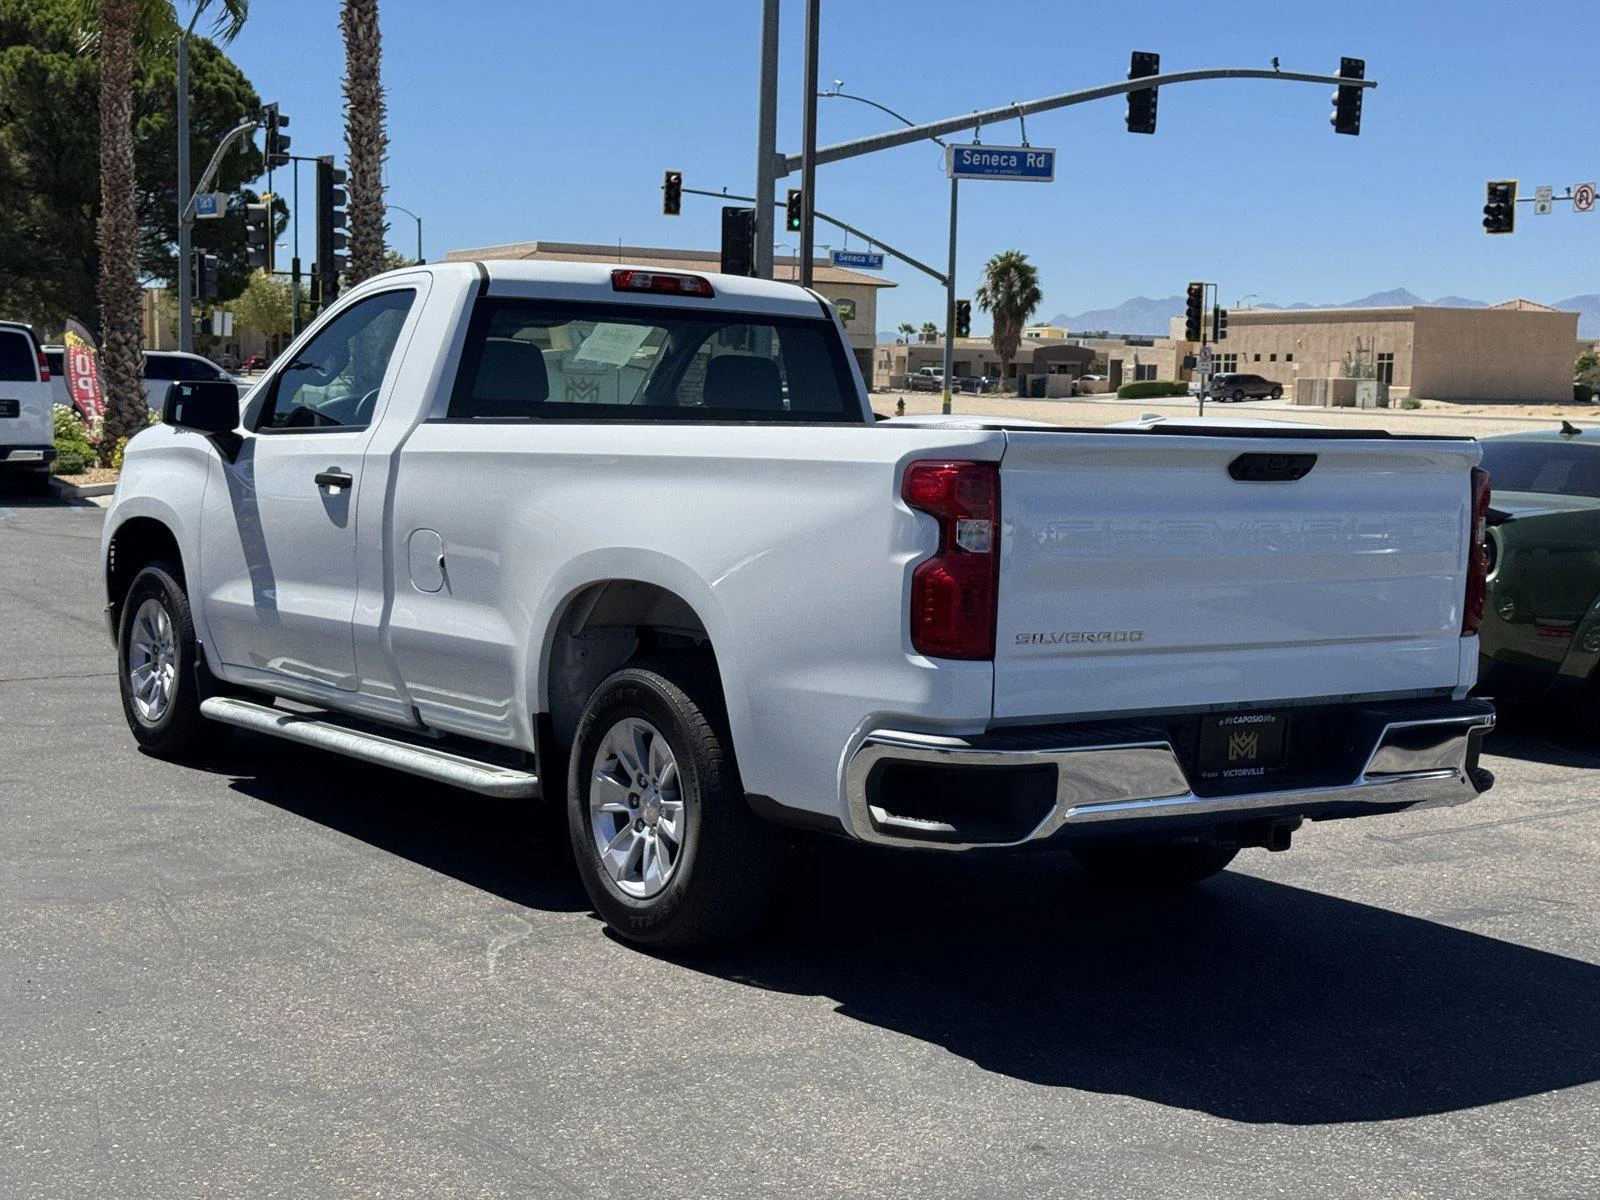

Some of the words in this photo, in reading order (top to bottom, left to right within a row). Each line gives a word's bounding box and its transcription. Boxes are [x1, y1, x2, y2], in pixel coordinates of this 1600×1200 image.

[962, 150, 1018, 167] Seneca
[1026, 153, 1046, 168] Rd
[1015, 630, 1145, 645] SILVERADO
[1223, 767, 1265, 778] VICTORVILLE
